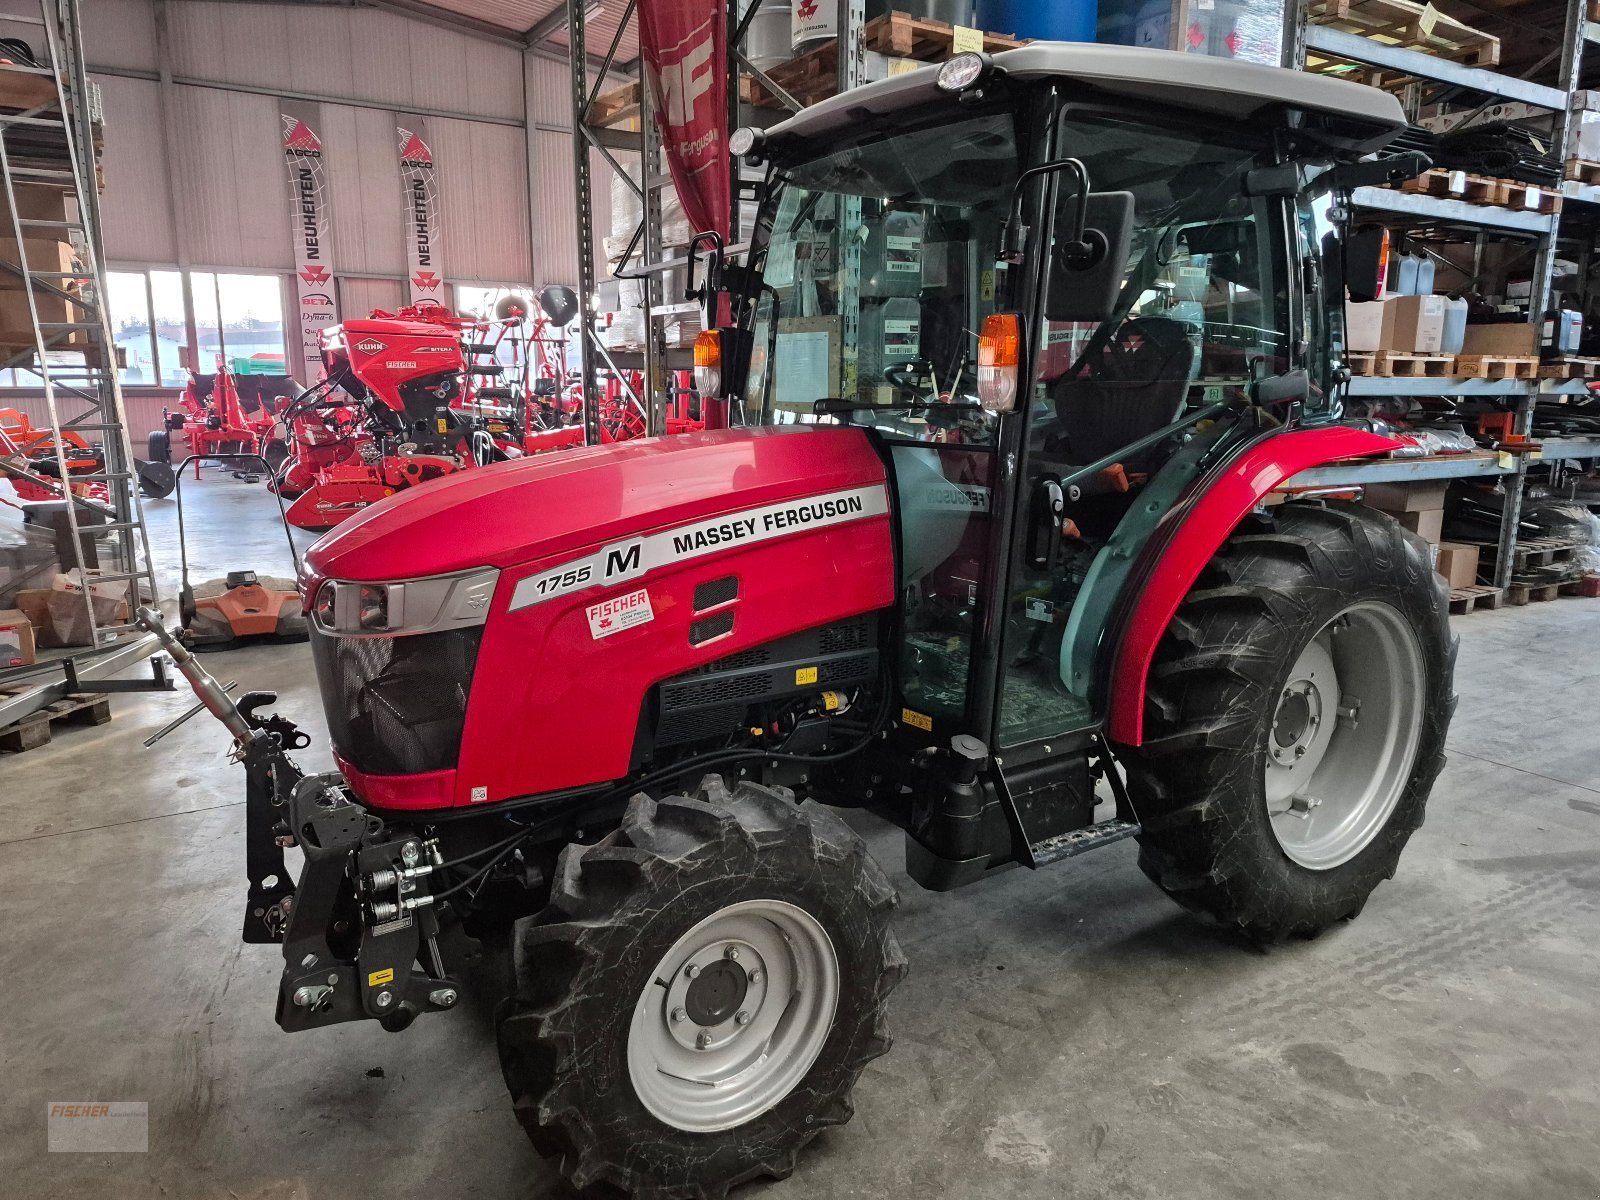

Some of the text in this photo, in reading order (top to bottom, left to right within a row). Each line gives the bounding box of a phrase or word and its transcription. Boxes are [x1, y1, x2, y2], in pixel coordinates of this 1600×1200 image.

[286, 149, 320, 158] AGCO
[401, 160, 433, 169] AGCO
[299, 168, 320, 260] NEUHEITEN
[412, 178, 431, 266] NEUHEITEN
[302, 298, 334, 306] BETA
[302, 312, 334, 322] Dyna-6
[536, 495, 863, 596] 1755 M MASSEY FERGUSON
[590, 591, 646, 621] FISCHER
